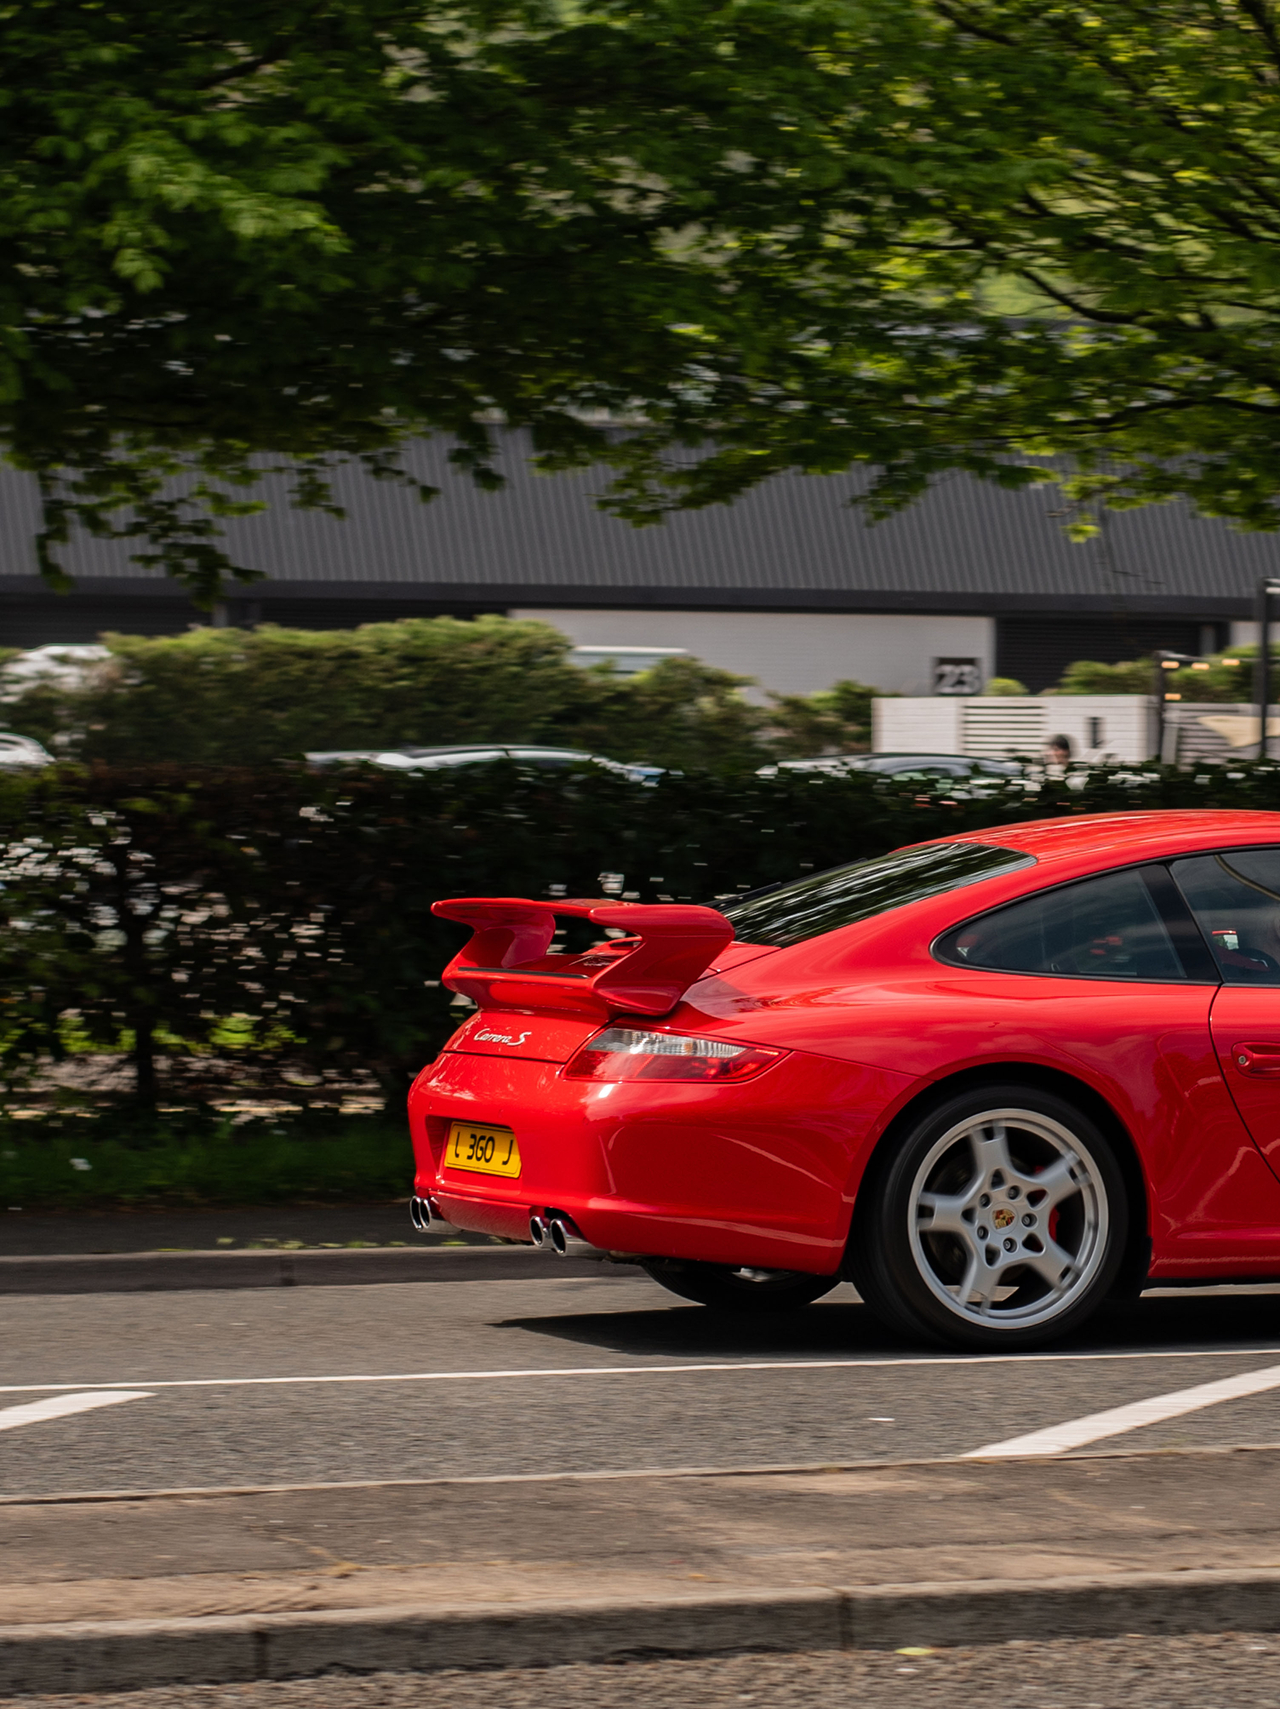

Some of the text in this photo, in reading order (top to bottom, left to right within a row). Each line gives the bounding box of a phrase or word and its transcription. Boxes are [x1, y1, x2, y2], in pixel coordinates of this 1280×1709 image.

[934, 664, 980, 694] 23
[473, 1028, 532, 1046] Carrera S
[501, 1139, 514, 1166] J
